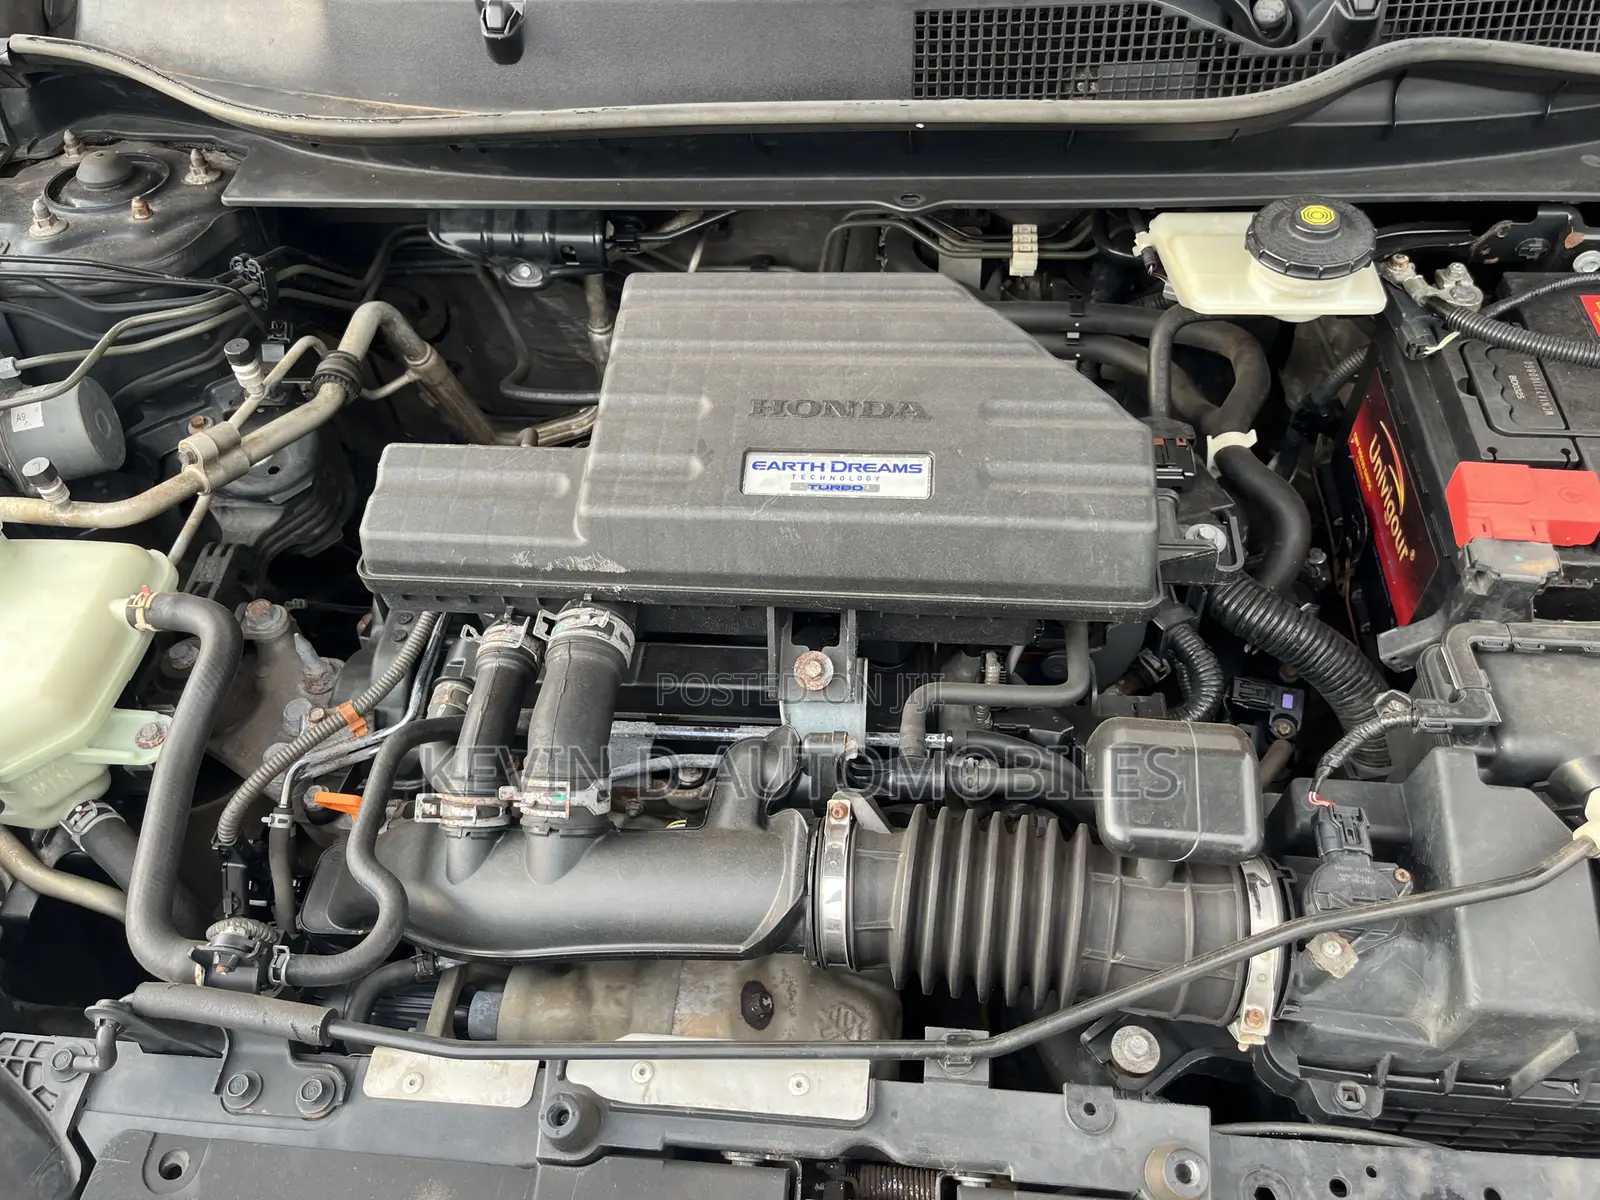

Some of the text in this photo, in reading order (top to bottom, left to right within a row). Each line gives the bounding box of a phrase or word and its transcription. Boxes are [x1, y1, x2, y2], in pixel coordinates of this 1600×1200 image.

[748, 399, 933, 421] HONDA
[752, 460, 923, 474] EARTH DREAMS
[791, 473, 881, 482] TECHNOLOGY
[808, 483, 864, 492] TURBO
[31, 767, 77, 798] MIN
